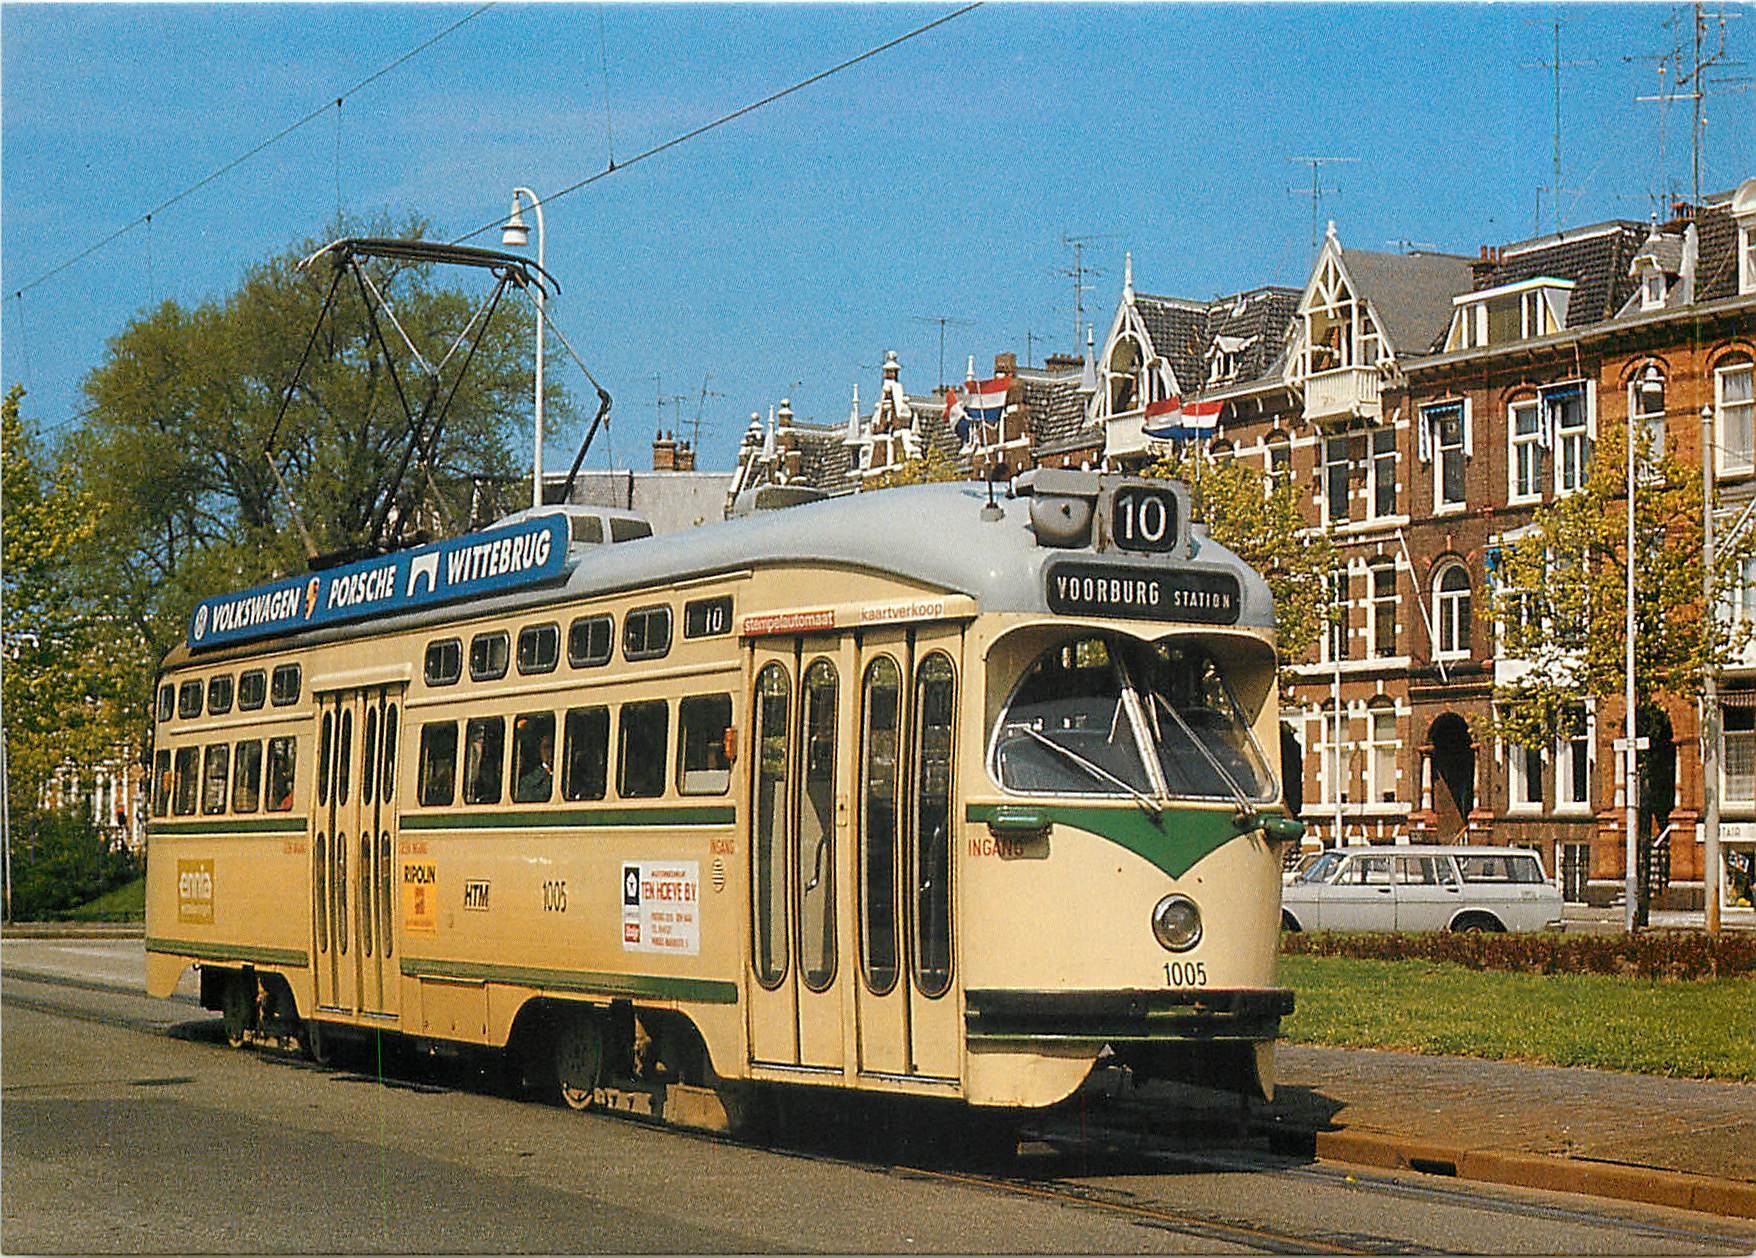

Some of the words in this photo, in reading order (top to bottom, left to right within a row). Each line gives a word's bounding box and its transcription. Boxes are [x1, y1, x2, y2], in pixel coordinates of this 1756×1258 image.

[1118, 495, 1167, 542] 10
[212, 587, 301, 634] VOLKSWAGEN
[327, 564, 397, 610] PORSCHE
[447, 528, 551, 585] WITTEBRUG
[1057, 576, 1160, 605] VOORBURG
[1174, 590, 1231, 609] STATION
[705, 607, 723, 633] 10
[743, 611, 834, 633] stempelautomaat
[861, 602, 943, 623] kaartverkoop
[404, 864, 436, 884] RIPOLIN
[464, 882, 490, 909] HTM
[542, 880, 568, 913] 1005
[1163, 961, 1208, 987] 1005
